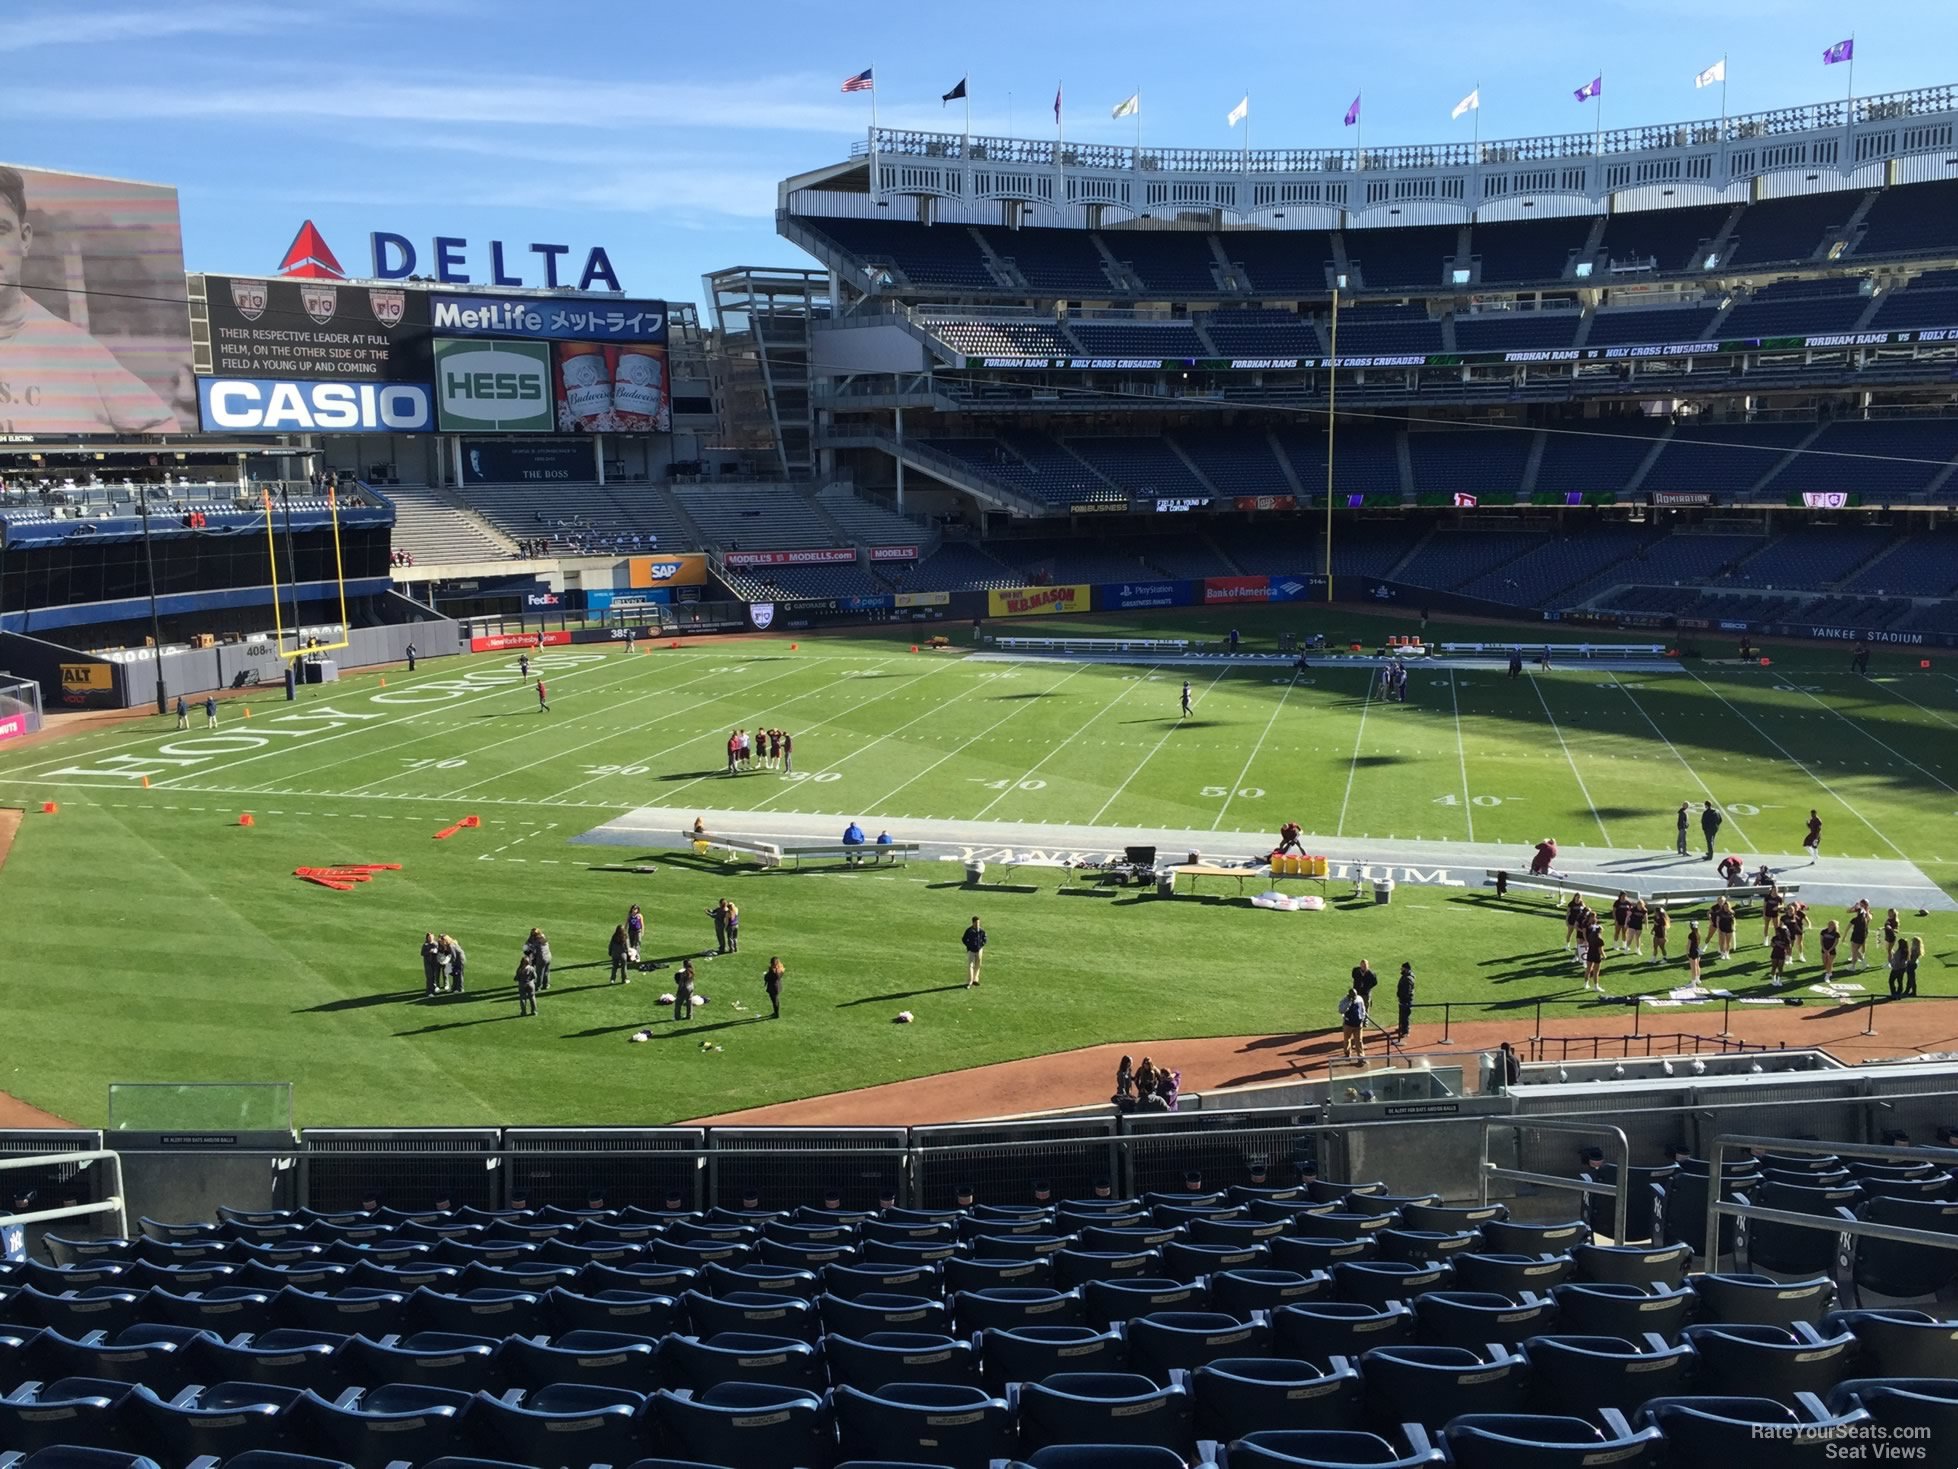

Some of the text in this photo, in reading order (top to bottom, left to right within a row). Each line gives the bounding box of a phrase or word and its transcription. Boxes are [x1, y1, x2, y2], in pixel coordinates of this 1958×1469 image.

[370, 231, 622, 291] DELTA
[434, 302, 664, 333] MetLife メットライフ
[219, 328, 390, 346] THEIR RESPECTIVE LEADER AT FULL
[1804, 336, 1855, 347] FORDHAM
[1856, 333, 1888, 344] RAMS
[1919, 331, 1948, 341] HOLY
[220, 344, 389, 360] HELM, ON THE OTHER SIDE OF THE
[1505, 351, 1547, 362] FORDHAM
[1548, 349, 1580, 360] RAMS
[1605, 346, 1630, 358] HOLY
[1631, 344, 1662, 356] CROSS
[1662, 343, 1720, 356] CRUSADERS
[222, 358, 377, 373] FIELD A YOUNG UP AND COMING
[983, 358, 1024, 368] FORDHAM
[1025, 359, 1049, 368] RAMS
[1071, 360, 1091, 368] HOLY
[1092, 360, 1117, 368] CROSS
[1117, 360, 1162, 369] CRUSADERS
[1230, 359, 1272, 368] FORDHAM
[1273, 359, 1298, 368] RAMS
[1348, 357, 1376, 366] CROSS
[1377, 356, 1426, 366] CRUSADERS
[447, 372, 541, 400] HESS
[210, 381, 428, 428] CASIO
[523, 470, 569, 479] THE BOSS
[789, 551, 853, 562] MODELLS.com
[651, 562, 677, 580] SAP
[1135, 585, 1173, 595] PlayStation
[1207, 586, 1277, 598] Bank of America
[528, 594, 559, 605] FedEx
[861, 596, 885, 608] pepsi
[1811, 627, 1923, 645] YANKEE STADIUM
[38, 650, 607, 781] HOLY CROSS
[984, 779, 1048, 791] 40
[1200, 786, 1266, 799] 50
[1433, 795, 1503, 807] 40
